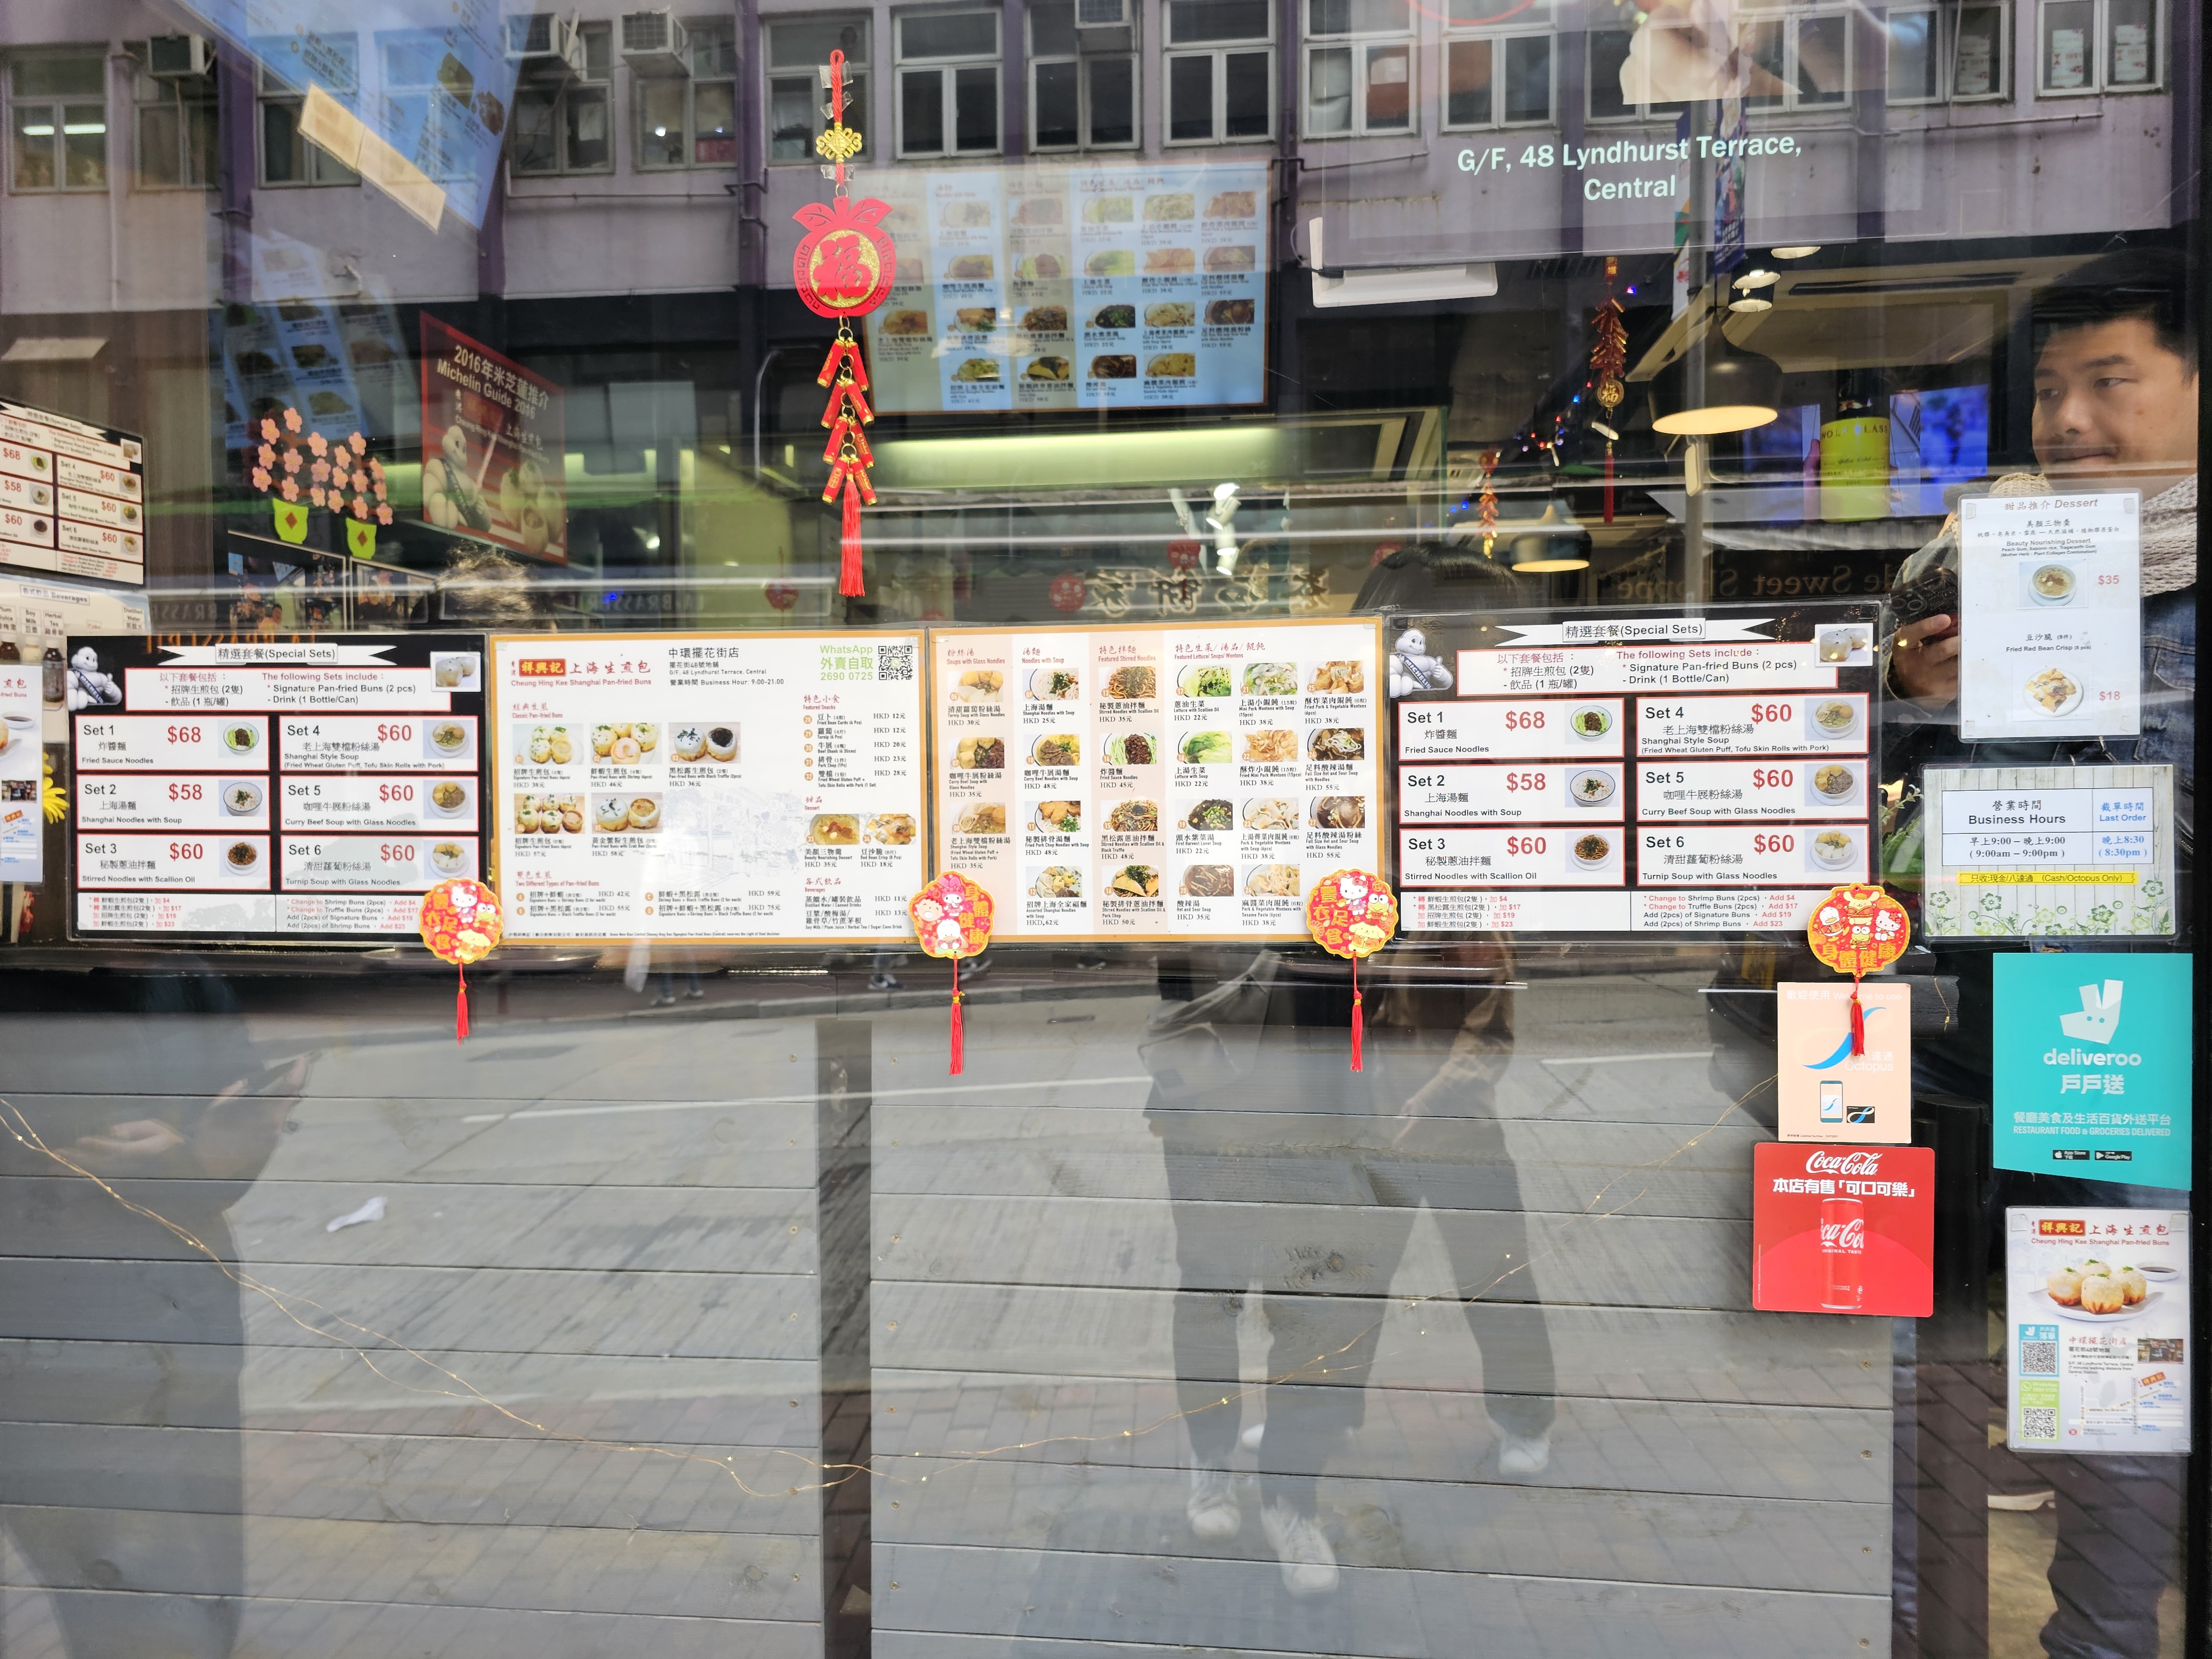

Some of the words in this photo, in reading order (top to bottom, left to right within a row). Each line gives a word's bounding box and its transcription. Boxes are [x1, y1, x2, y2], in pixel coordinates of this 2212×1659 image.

[1457, 147, 1511, 176] G/F,
[1519, 145, 1554, 168] 48
[1563, 141, 1688, 170] Lyndhurst
[1697, 135, 1802, 159] Terrace,
[1584, 175, 1676, 200] Central
[437, 358, 481, 393] Michelin
[483, 383, 512, 408] Guide
[514, 398, 536, 420] 2016
[3, 447, 21, 461] $68
[100, 469, 116, 482] $60
[4, 479, 22, 493] $58
[2004, 500, 2051, 510] 甜品推介
[2054, 498, 2099, 509] Dessert
[5, 514, 23, 526] $60
[102, 531, 117, 544] $60
[2098, 575, 2120, 586] $35
[1672, 624, 1703, 637] Sets)
[309, 649, 335, 660] Sets)
[820, 645, 873, 655] WhatsApp
[820, 656, 874, 670] 外賣自取
[1052, 656, 1065, 665] Soup
[820, 672, 845, 681] 2690
[848, 671, 873, 681] 0725
[1405, 659, 1432, 690] MICHELIN
[1629, 674, 1657, 684] Drink
[1660, 675, 1667, 685] (1
[1672, 674, 1729, 684] Bottle/Can)
[510, 680, 537, 688] Cheung
[538, 680, 554, 688] Hing
[570, 679, 601, 687] Shanghai
[2099, 691, 2121, 701] $18
[1751, 703, 1792, 724] $60
[1505, 710, 1545, 732] $68
[84, 724, 105, 735] Set
[109, 724, 114, 735] 1
[167, 725, 201, 745] $68
[377, 723, 412, 743] $60
[1506, 771, 1546, 794] $58
[1752, 768, 1793, 790] $60
[85, 784, 106, 795] Set
[109, 784, 117, 795] 2
[169, 782, 202, 802] $58
[379, 784, 414, 803] $60
[1992, 799, 2042, 811] 營業時間
[1642, 808, 1666, 817] Curry
[1689, 808, 1712, 816] Soup
[1969, 815, 2025, 825] Business
[2030, 814, 2066, 824] Hours
[1507, 836, 1546, 857] $60
[1754, 833, 1794, 855] $60
[1969, 837, 2011, 847] 早上9:00
[2023, 836, 2065, 846] 晚上9:00
[2102, 836, 2145, 845] 晚上8:30
[169, 842, 203, 862] $60
[380, 843, 415, 863] $60
[2042, 874, 2100, 883] (Cash/Octopus
[2101, 874, 2122, 883] Only)
[1786, 989, 1830, 1000] 歡迎使用
[1834, 992, 1872, 1000] Welme
[2043, 1048, 2142, 1066] deliveroo
[1844, 1060, 1894, 1074] Octopus
[2060, 1074, 2128, 1097] 戶戶送
[2013, 1110, 2171, 1127] 餐廳美食及生活百貨外送平台
[2013, 1125, 2060, 1135] RESTAURANT
[2060, 1126, 2081, 1135] FOOD
[2089, 1127, 2131, 1136] GROCERIES
[2131, 1128, 2171, 1136] DELIVERED
[1806, 1150, 1883, 1176] Coca-Cola
[1773, 1178, 1915, 1197] 本店有售「可口可樂」
